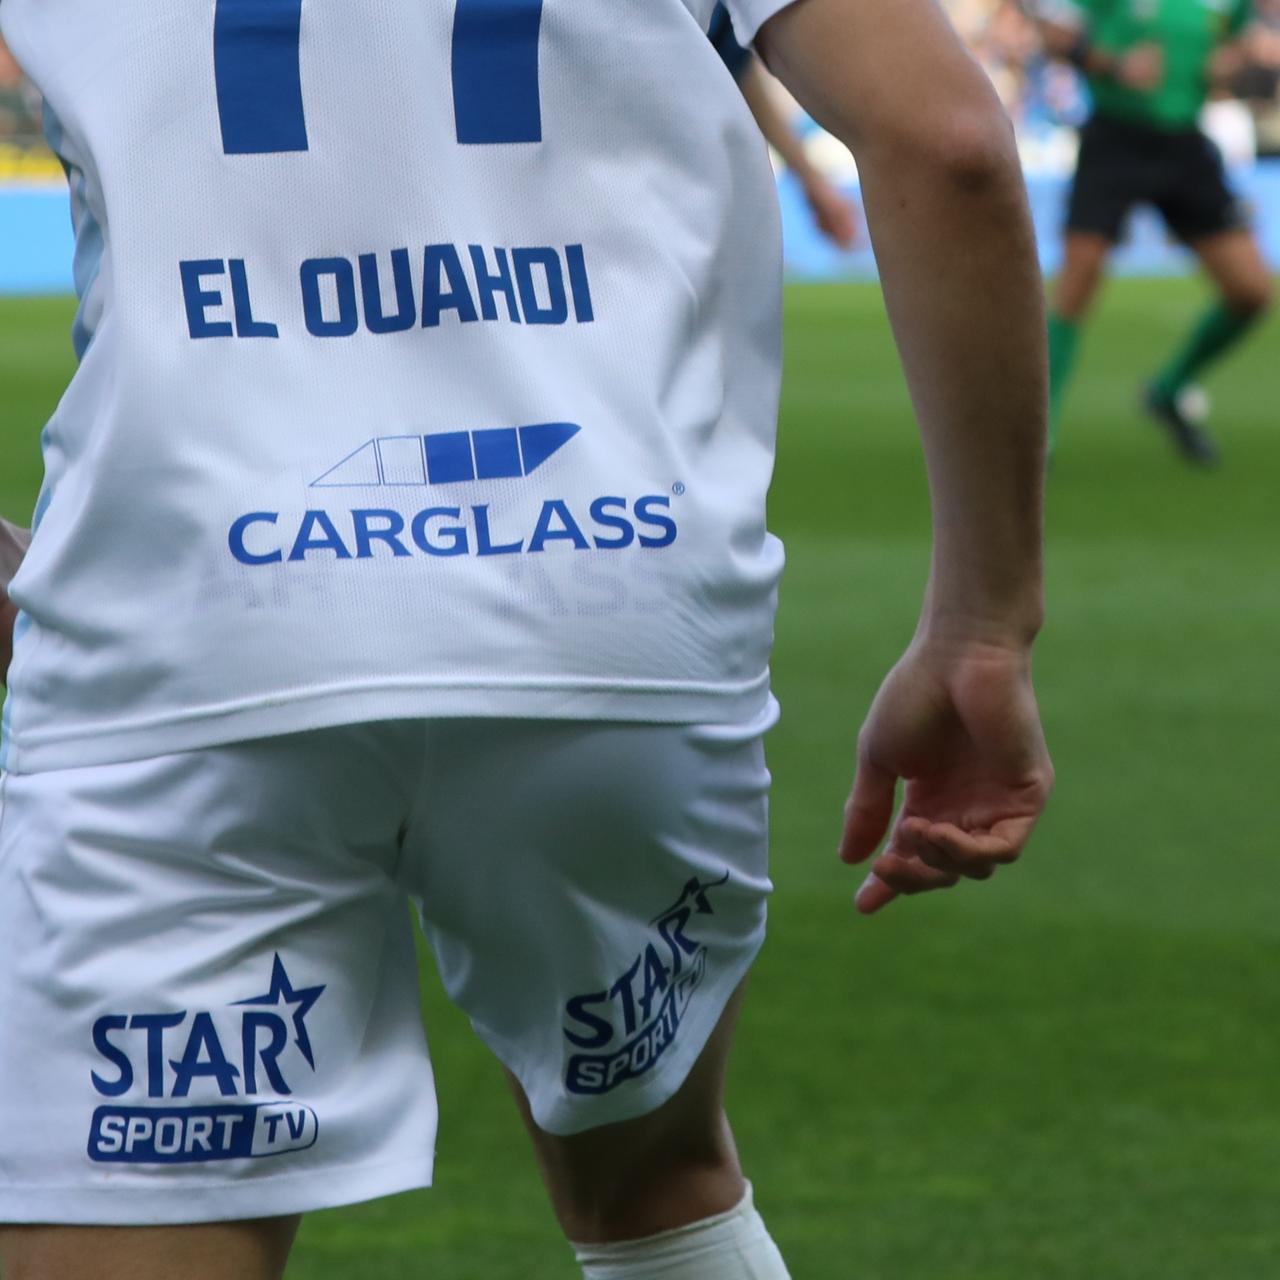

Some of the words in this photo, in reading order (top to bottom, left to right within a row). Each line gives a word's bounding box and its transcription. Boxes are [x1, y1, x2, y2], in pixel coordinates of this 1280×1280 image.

[179, 258, 279, 339] EL
[300, 243, 595, 337] OUAHDI
[563, 906, 701, 1050] STAR
[91, 1009, 293, 1098] STAR
[576, 1009, 675, 1088] SPORT
[96, 1114, 244, 1155] SPORT
[263, 1109, 306, 1144] TV
